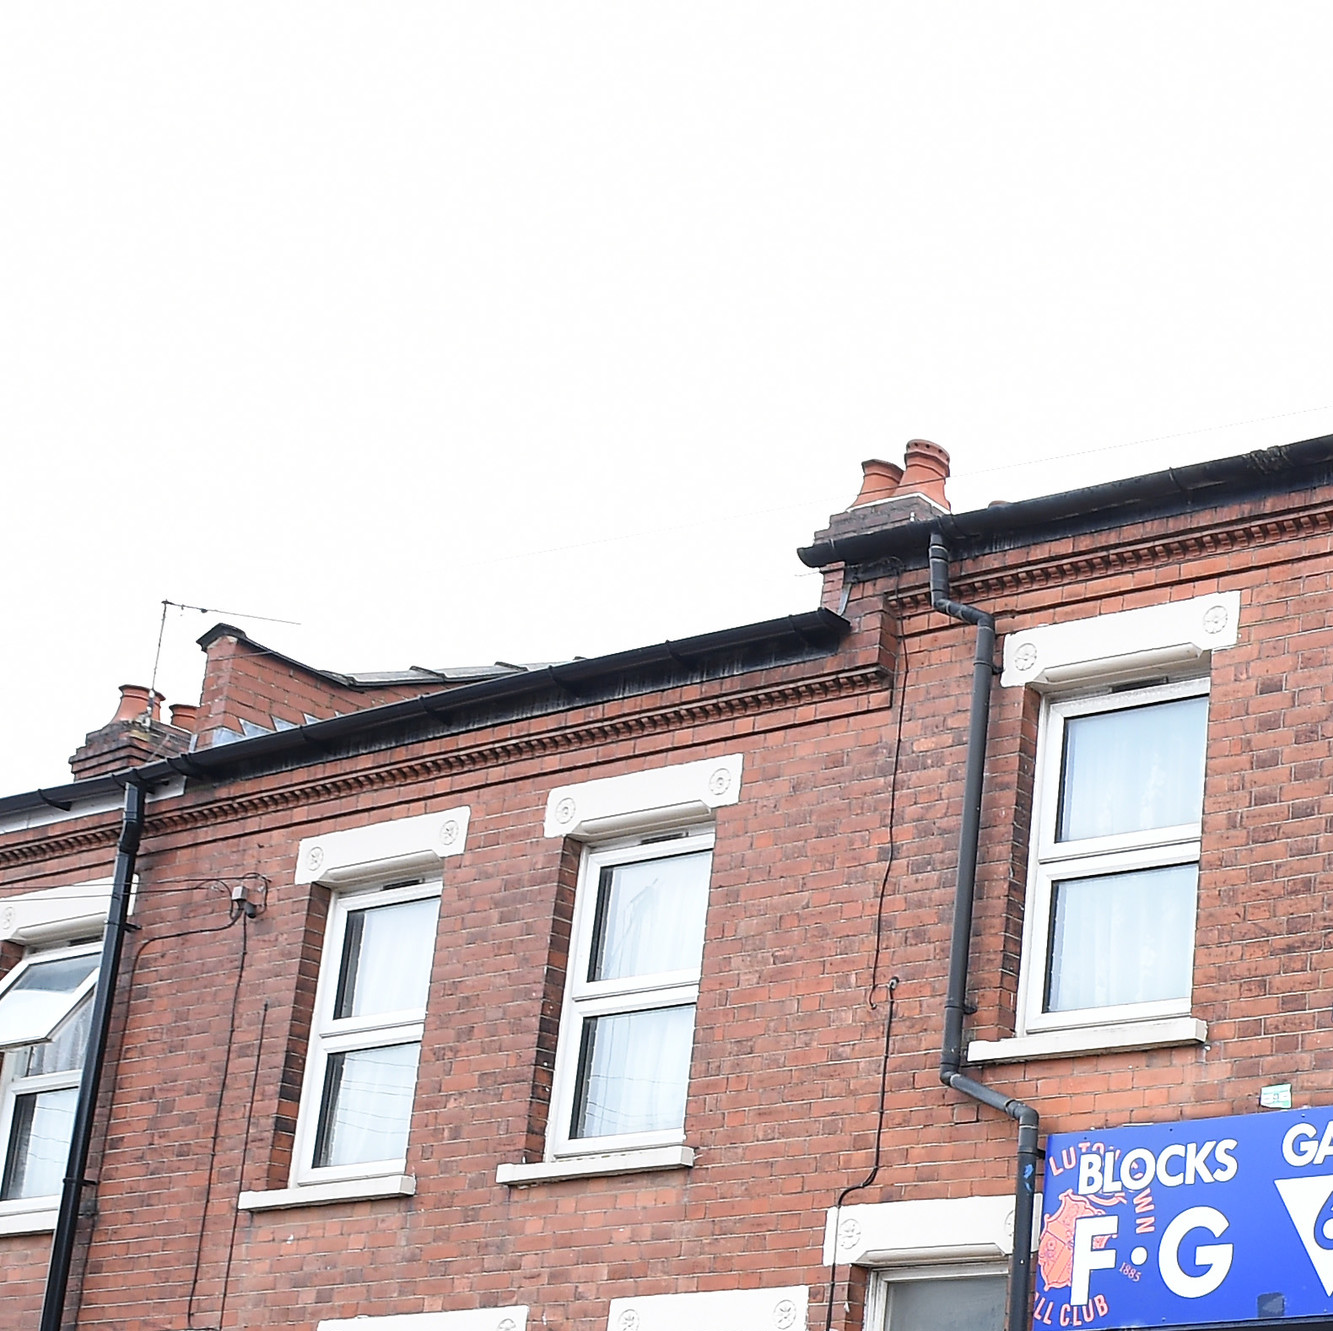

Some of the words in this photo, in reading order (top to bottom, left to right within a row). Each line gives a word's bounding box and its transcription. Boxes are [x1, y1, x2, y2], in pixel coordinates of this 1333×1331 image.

[1078, 1139, 1239, 1195] BLOCKS
[1119, 1261, 1142, 1282] 1885
[1034, 1291, 1055, 1325] LL
[1060, 1294, 1109, 1327] CLUB
